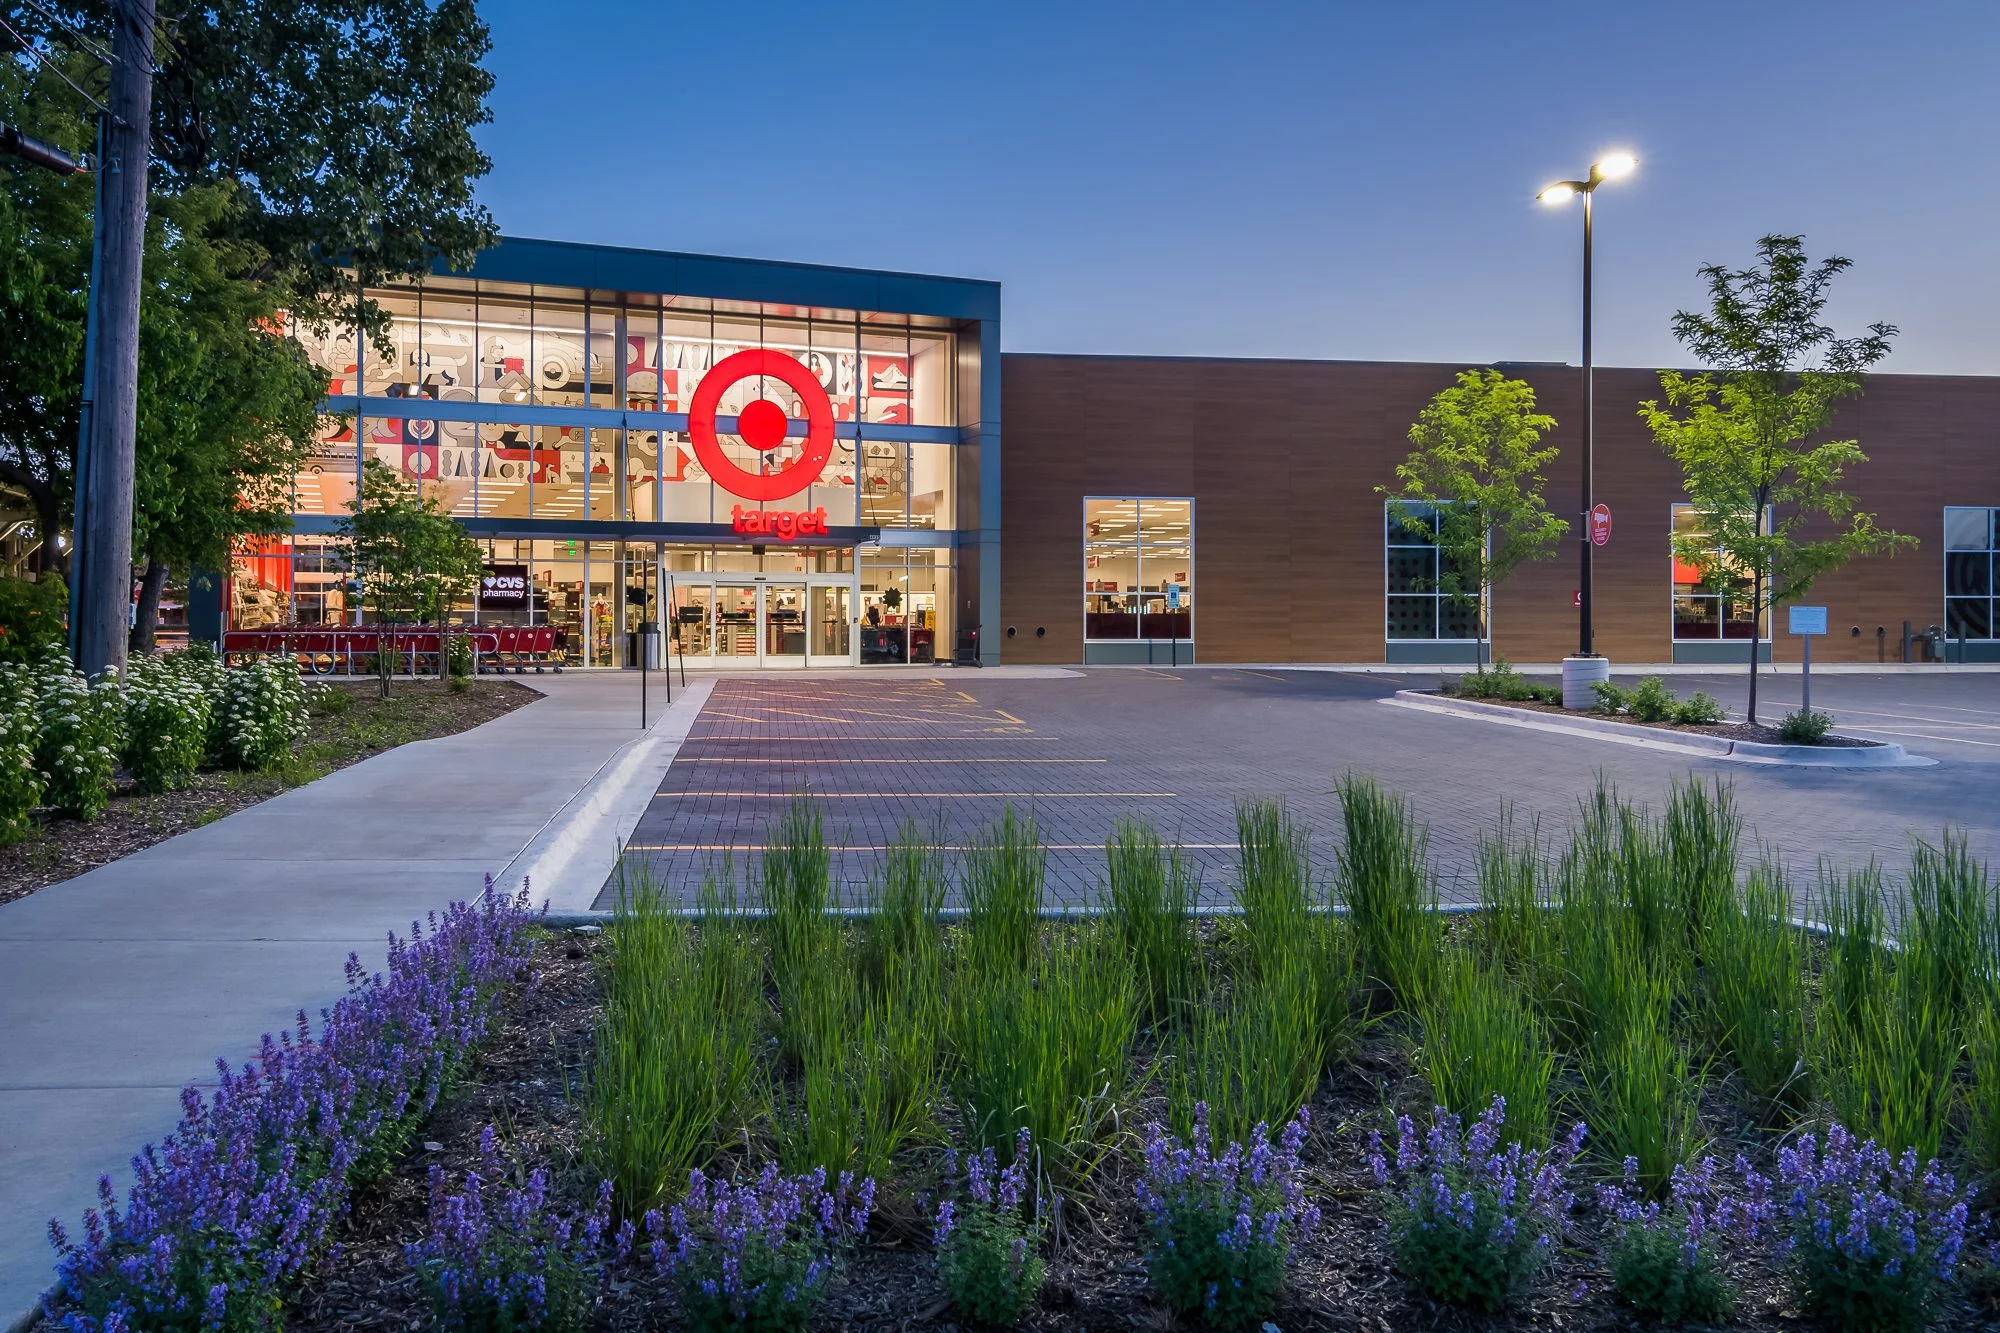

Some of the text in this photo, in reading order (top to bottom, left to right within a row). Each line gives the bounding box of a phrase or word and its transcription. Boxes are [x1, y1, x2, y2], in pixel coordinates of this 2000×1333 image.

[731, 504, 828, 540] target
[496, 576, 525, 589] CVS
[483, 588, 524, 599] pharmacy
